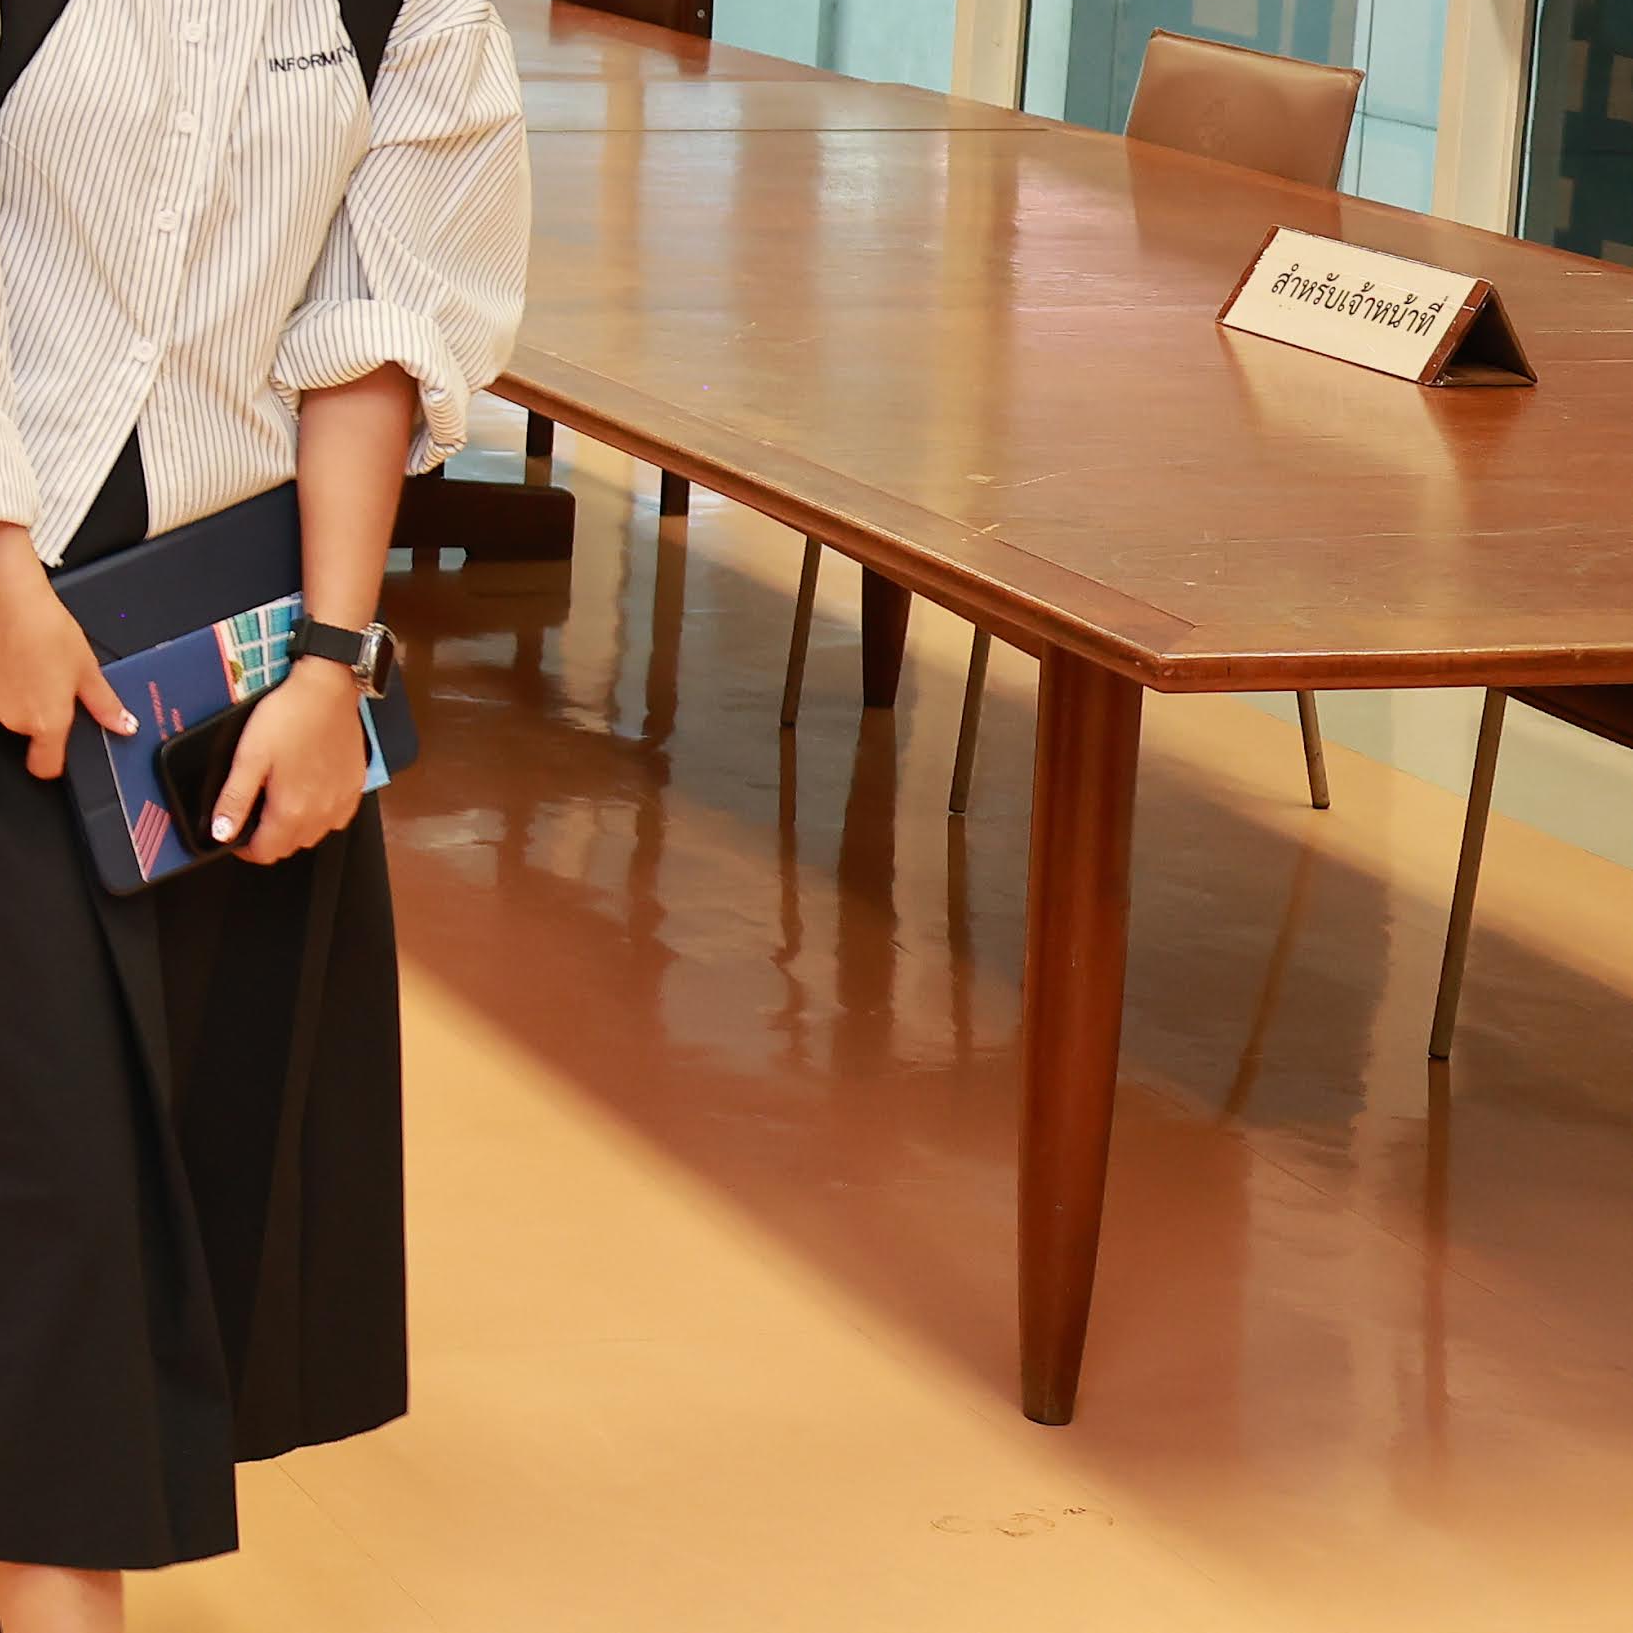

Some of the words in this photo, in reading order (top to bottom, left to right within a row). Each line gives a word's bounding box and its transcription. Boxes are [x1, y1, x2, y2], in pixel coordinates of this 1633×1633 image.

[1271, 262, 1449, 337] สำหรับเจ้าหน้าที่
